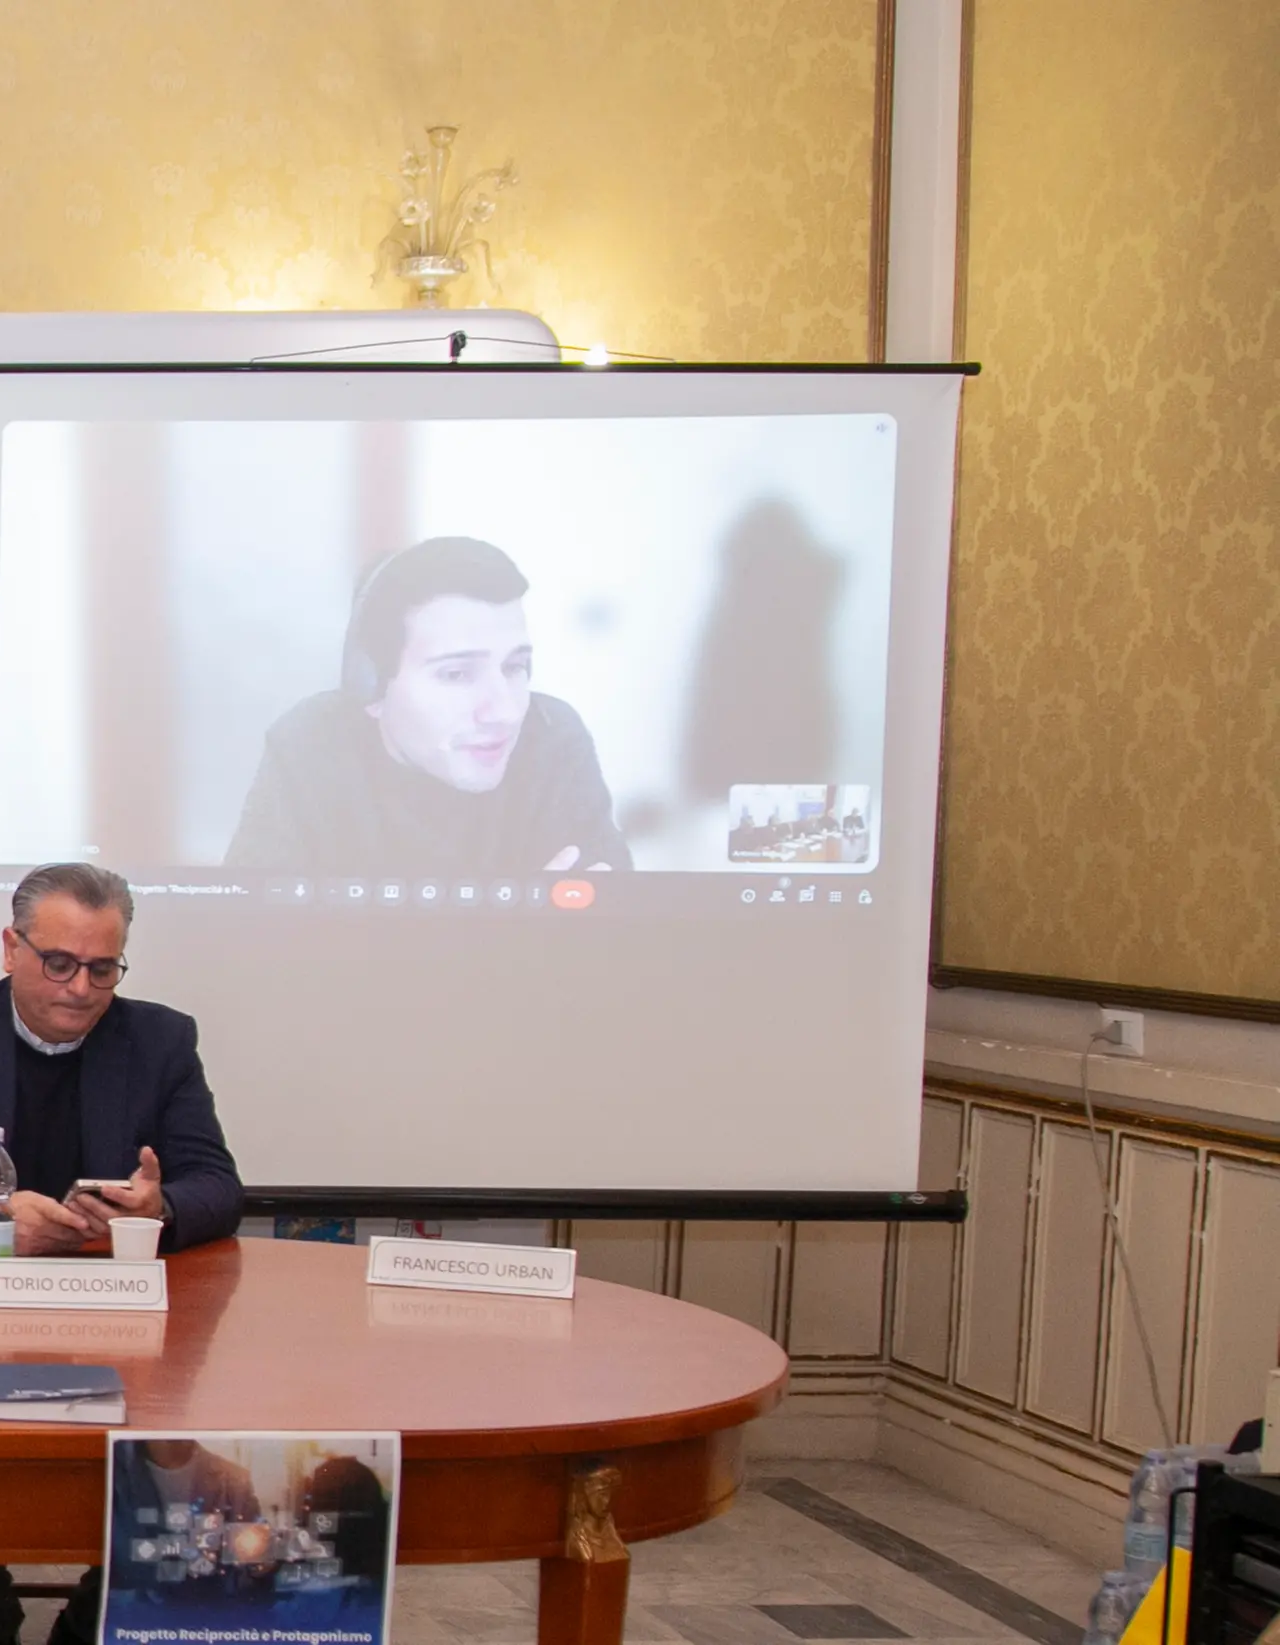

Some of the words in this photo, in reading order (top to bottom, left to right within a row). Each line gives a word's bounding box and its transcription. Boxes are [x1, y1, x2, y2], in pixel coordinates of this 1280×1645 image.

[393, 1256, 489, 1276] FRANCESCO
[494, 1264, 553, 1280] URBAN
[59, 1278, 148, 1293] COLOSIMO
[116, 1628, 177, 1643] Progetto
[180, 1628, 259, 1643] Reciprocità
[262, 1631, 270, 1641] e
[273, 1629, 371, 1644] Protagonismo
